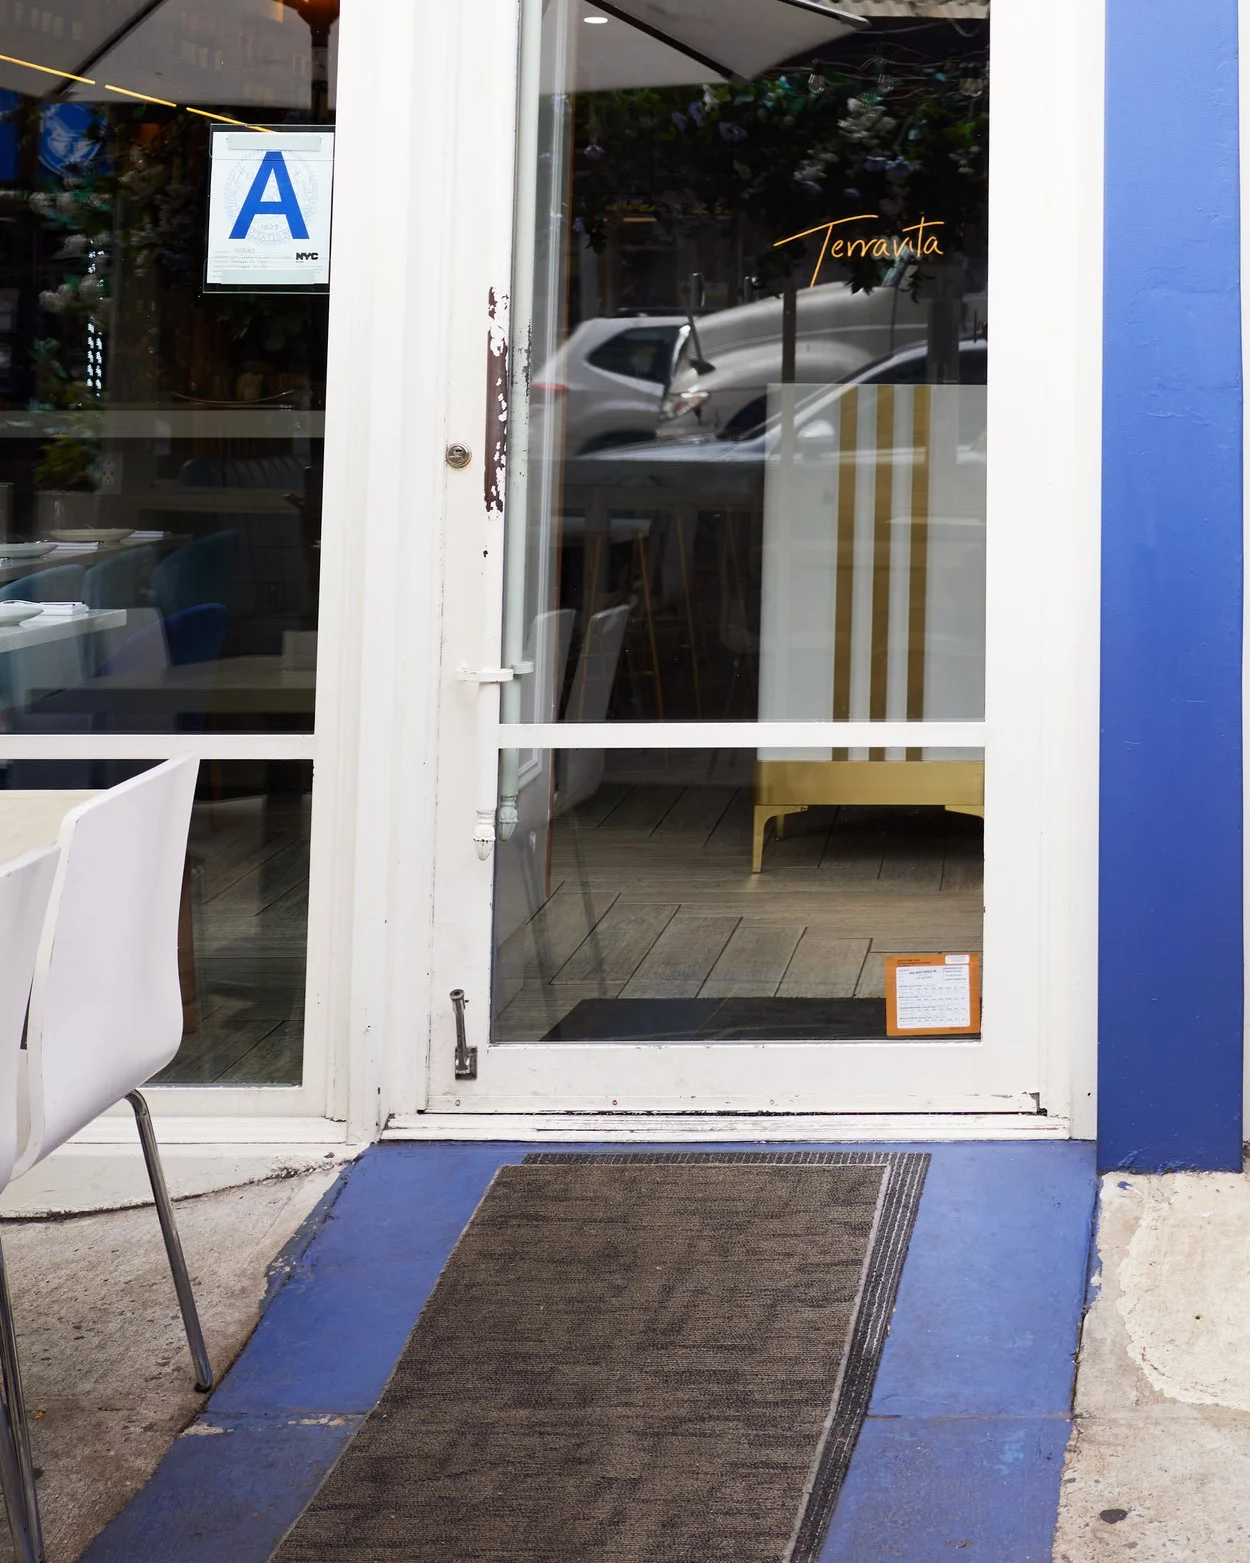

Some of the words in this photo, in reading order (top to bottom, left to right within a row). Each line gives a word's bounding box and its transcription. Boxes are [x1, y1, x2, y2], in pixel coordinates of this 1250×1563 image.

[229, 151, 311, 240] A
[296, 252, 319, 261] NYC
[772, 214, 945, 288] Terravita
